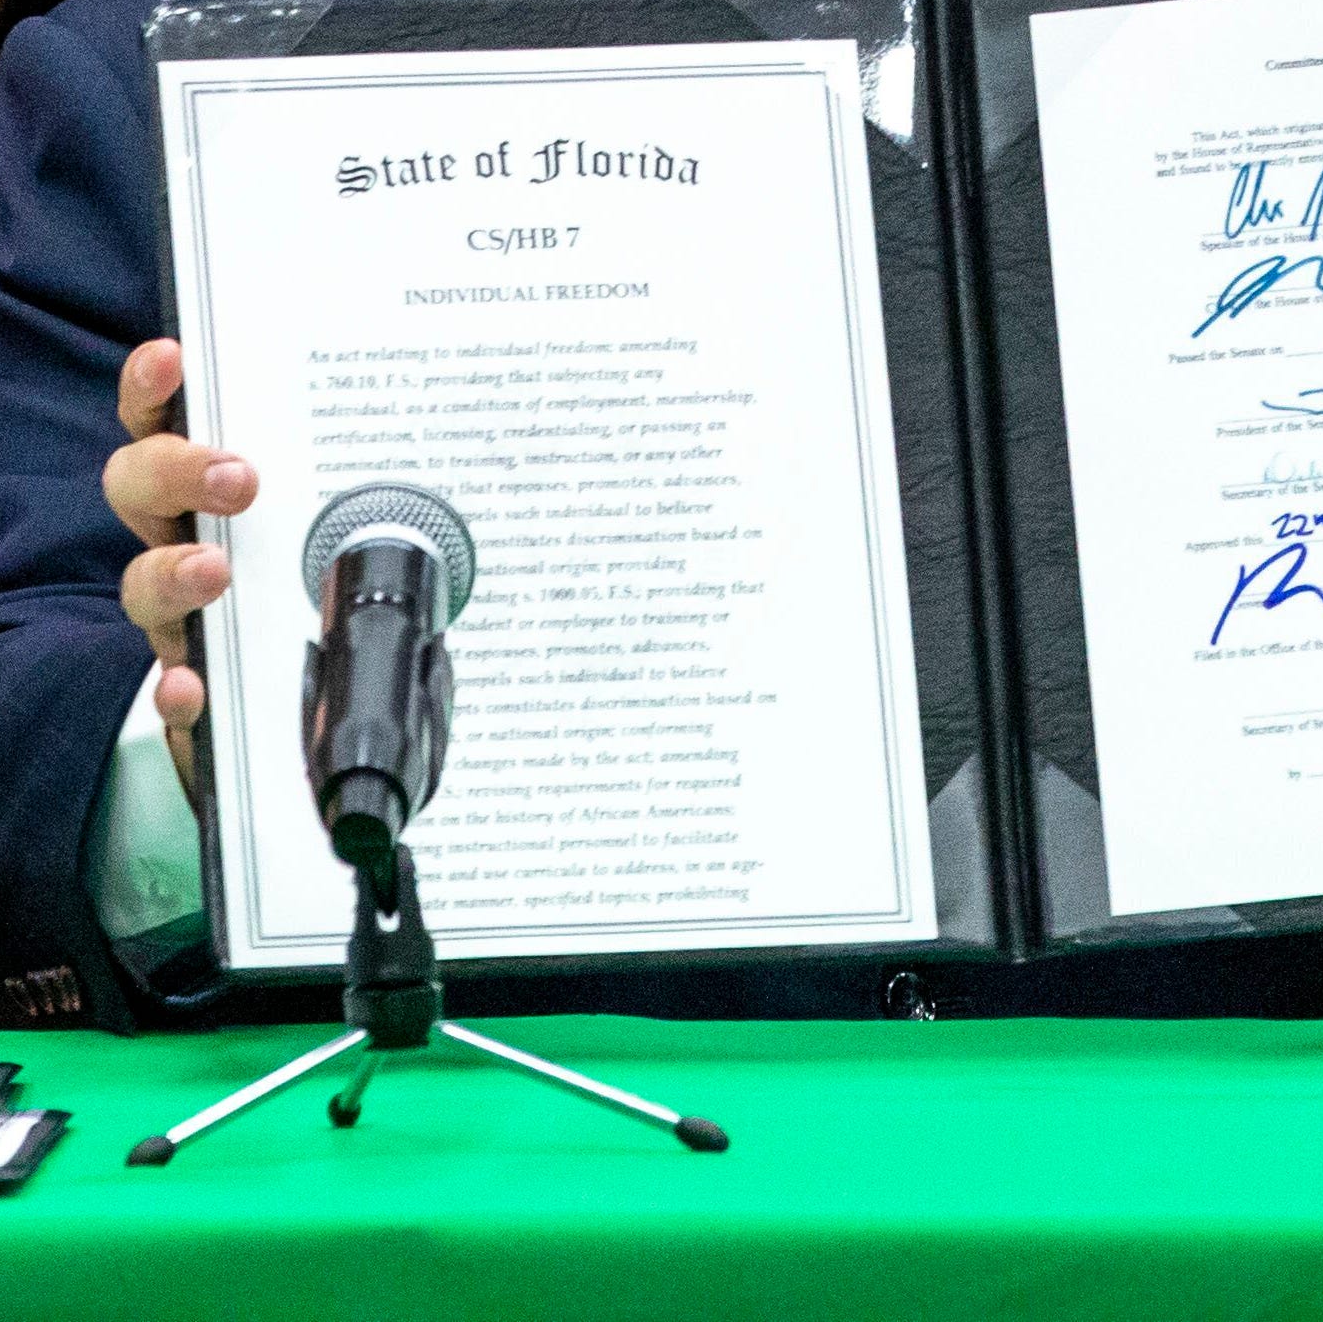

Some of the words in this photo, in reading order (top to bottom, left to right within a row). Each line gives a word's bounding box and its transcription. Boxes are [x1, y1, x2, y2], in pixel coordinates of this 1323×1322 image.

[336, 151, 457, 198] State
[475, 141, 511, 178] of
[529, 139, 700, 185] Florida
[467, 228, 559, 255] CS/HB
[566, 227, 581, 248] 7
[405, 286, 536, 306] INDIVIDUAL
[545, 282, 651, 301] FREEDOM
